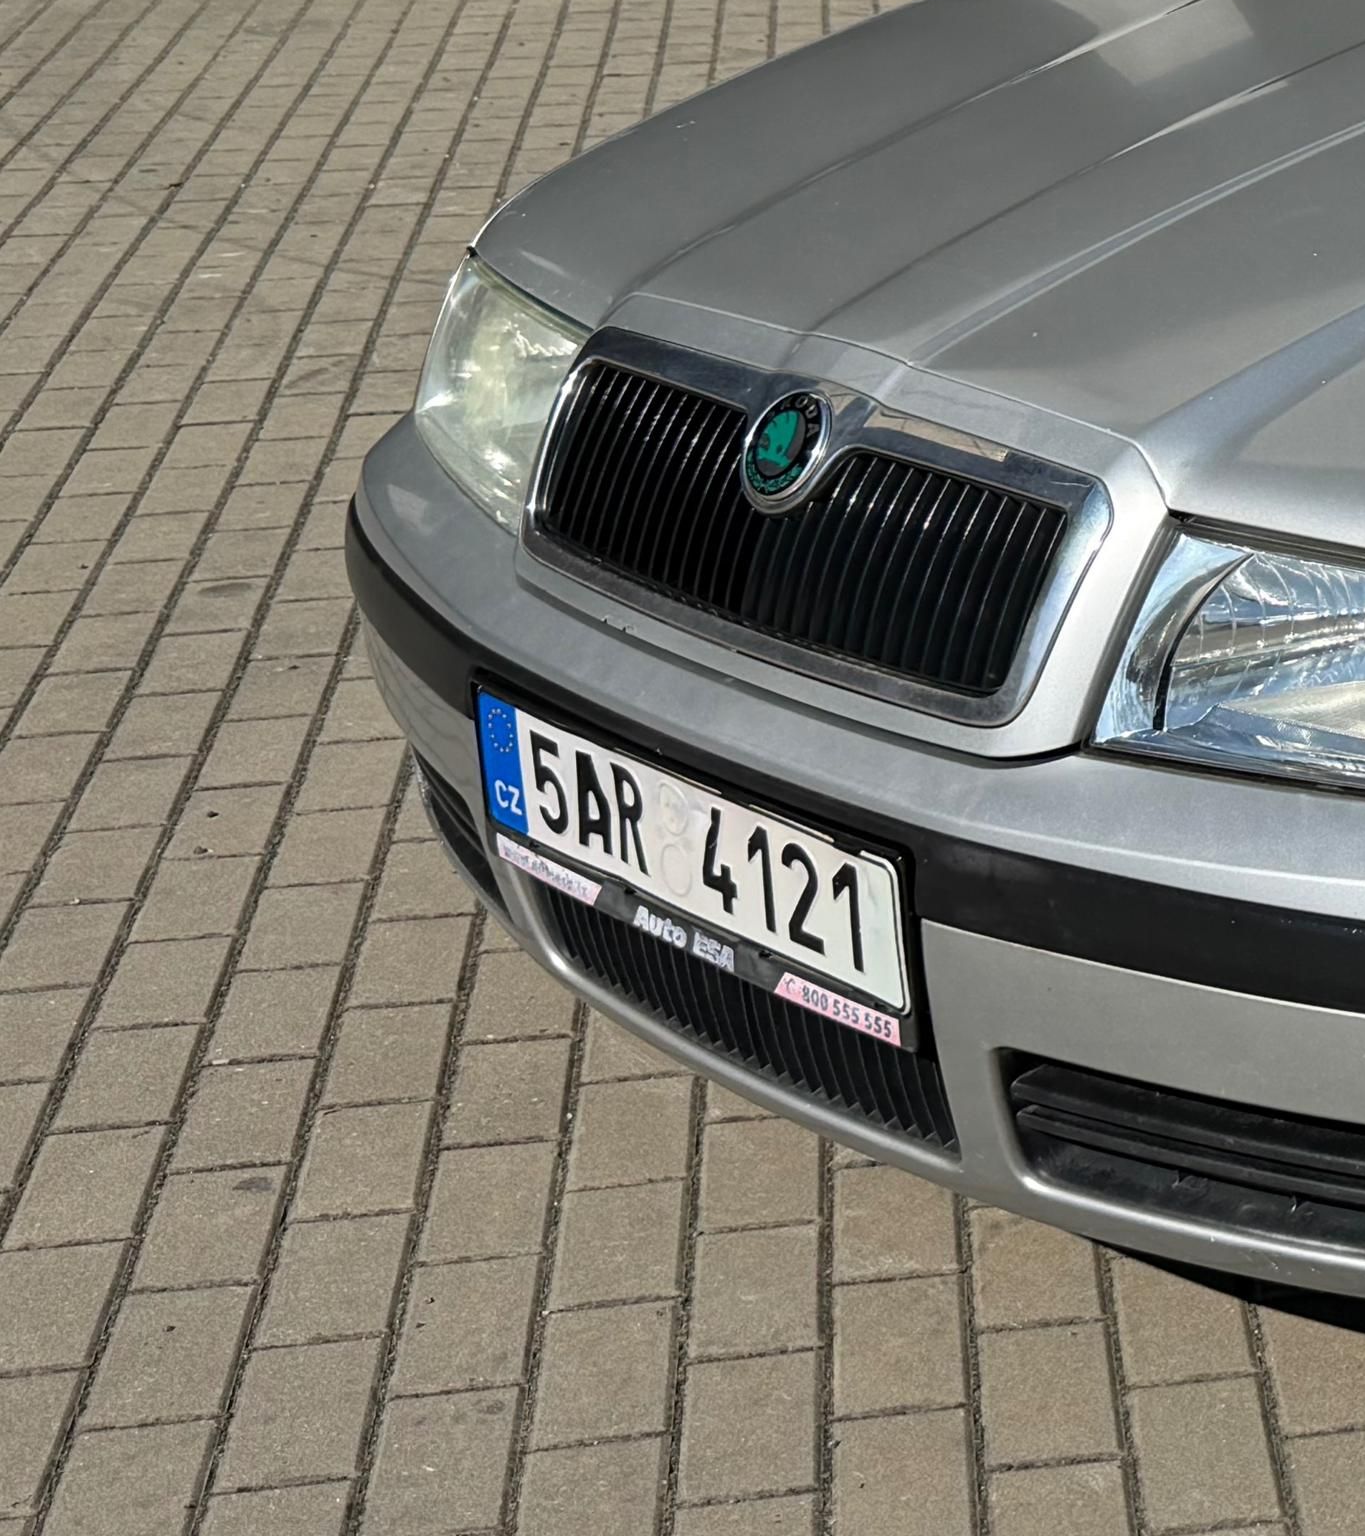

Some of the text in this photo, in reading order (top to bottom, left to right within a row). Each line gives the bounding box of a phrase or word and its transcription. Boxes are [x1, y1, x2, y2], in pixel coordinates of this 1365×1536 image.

[494, 778, 523, 817] CZ
[529, 729, 866, 974] 5AR 4121
[632, 905, 735, 974] Auto ESA
[832, 999, 860, 1025] 555
[864, 1012, 893, 1039] 555
